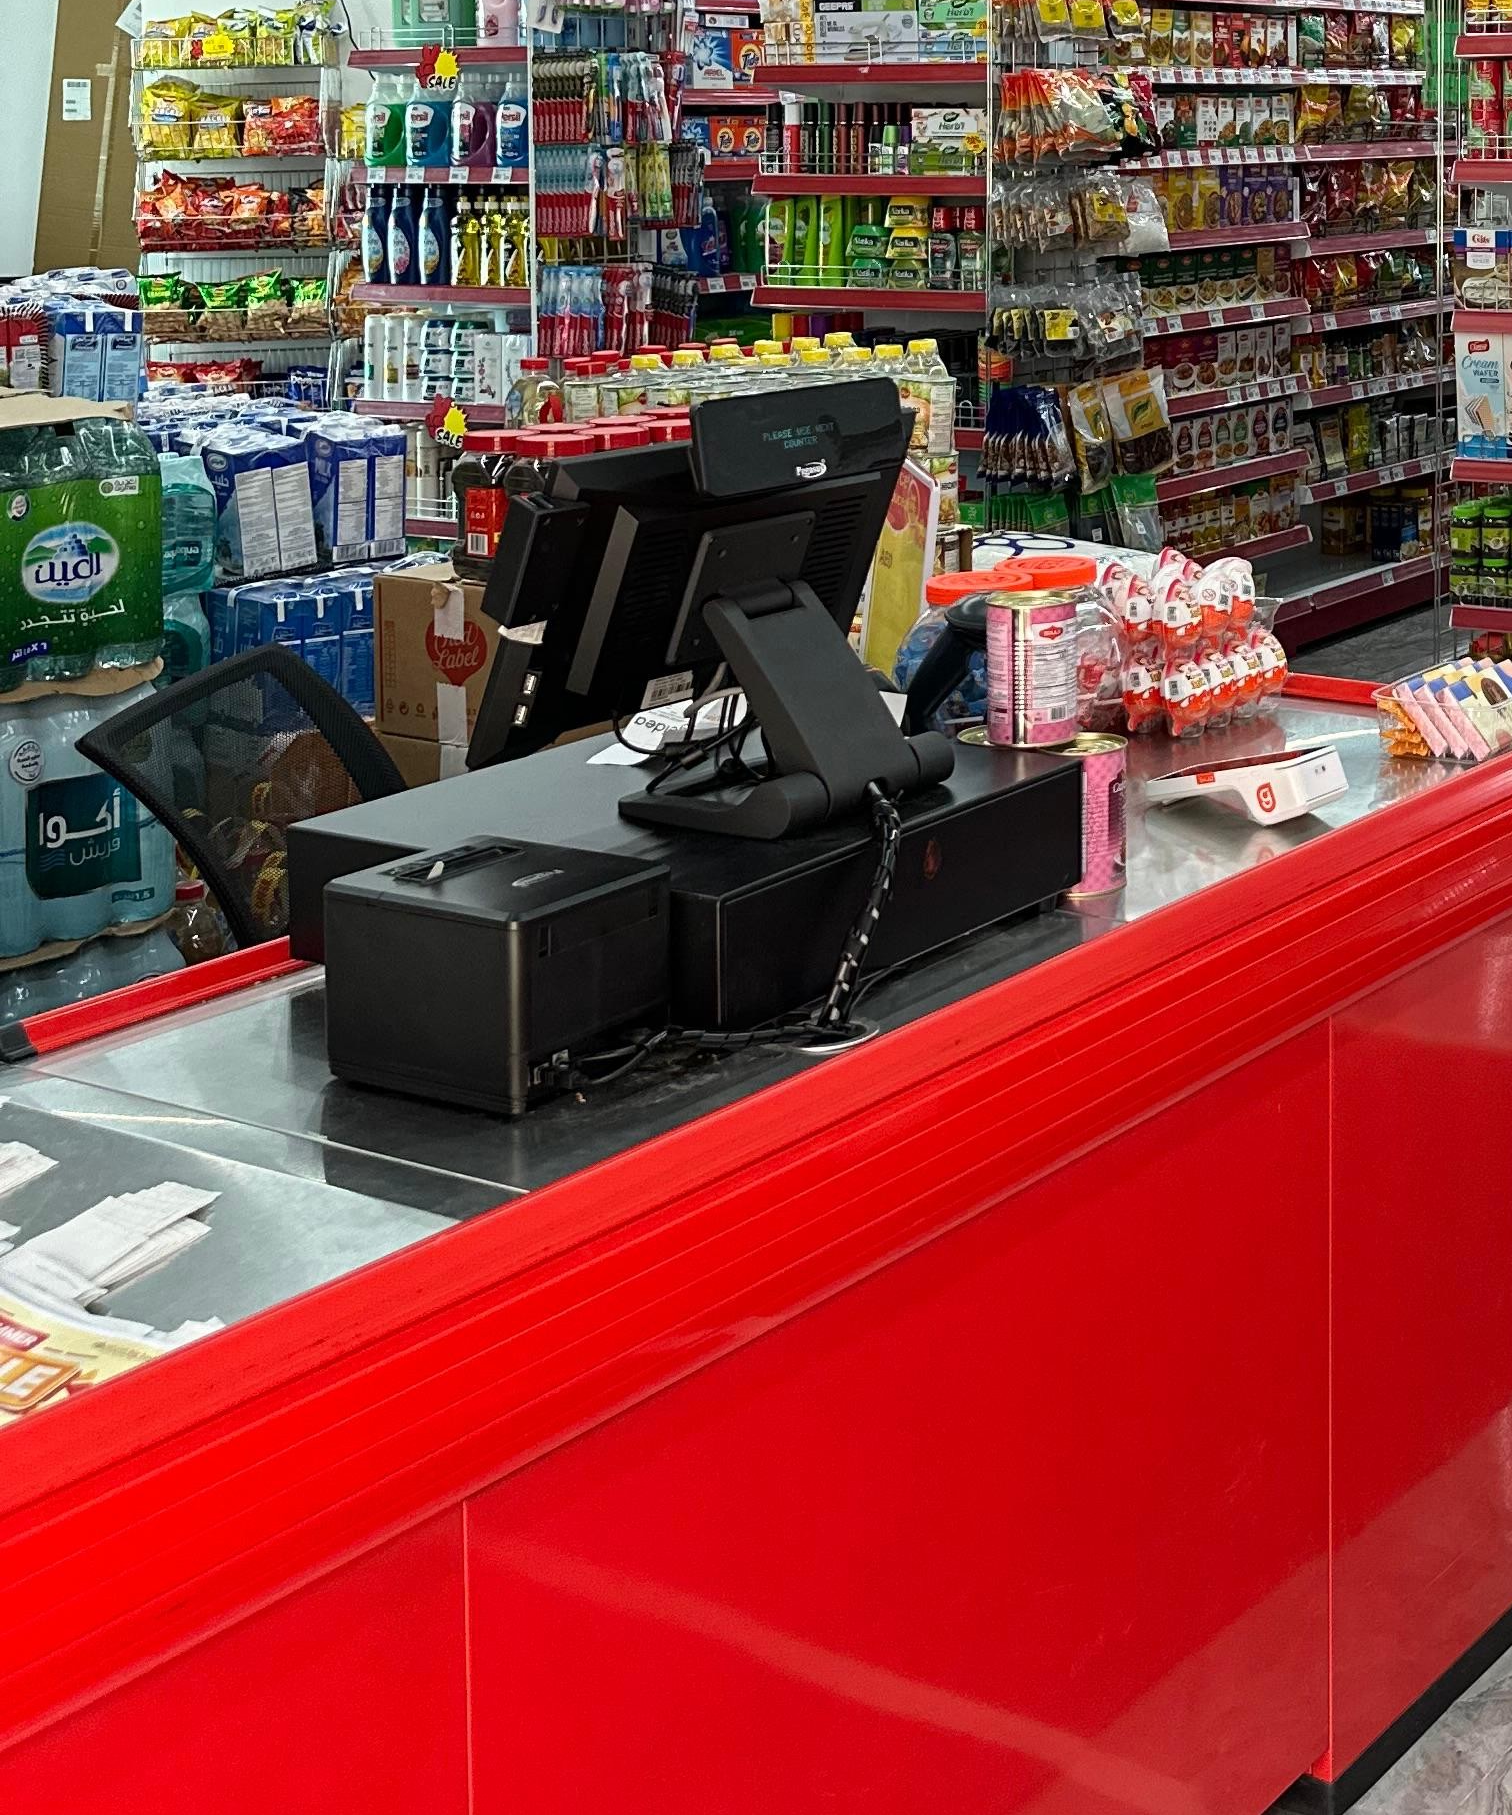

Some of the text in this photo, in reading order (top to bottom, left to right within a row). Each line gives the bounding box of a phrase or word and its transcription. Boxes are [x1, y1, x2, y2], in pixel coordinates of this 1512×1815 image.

[428, 76, 456, 89] SALE
[1461, 357, 1499, 370] Cream
[1473, 369, 1498, 377] WAFER
[436, 429, 464, 449] SALE
[762, 422, 835, 441] PLEASE USE NEXT
[784, 436, 818, 449] COUNTER
[35, 551, 103, 586] العين
[20, 609, 75, 630] تتجدد
[433, 648, 479, 670] Label
[39, 787, 121, 849] أكوا
